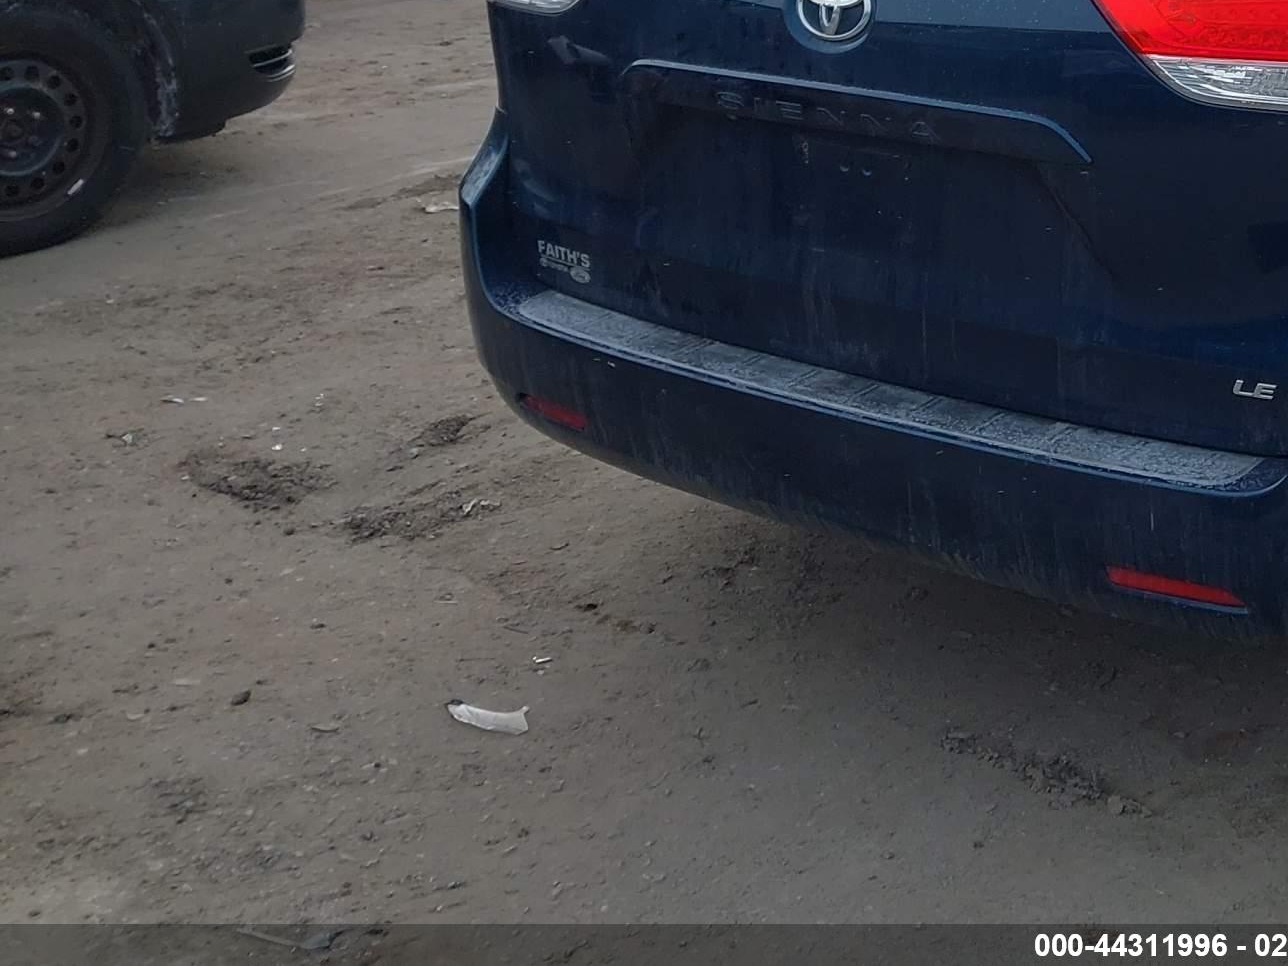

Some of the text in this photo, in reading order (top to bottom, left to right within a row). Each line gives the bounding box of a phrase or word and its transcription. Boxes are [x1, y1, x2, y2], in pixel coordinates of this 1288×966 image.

[714, 91, 943, 147] SIENNA
[537, 240, 591, 268] FAITH'S
[1233, 379, 1278, 400] LE
